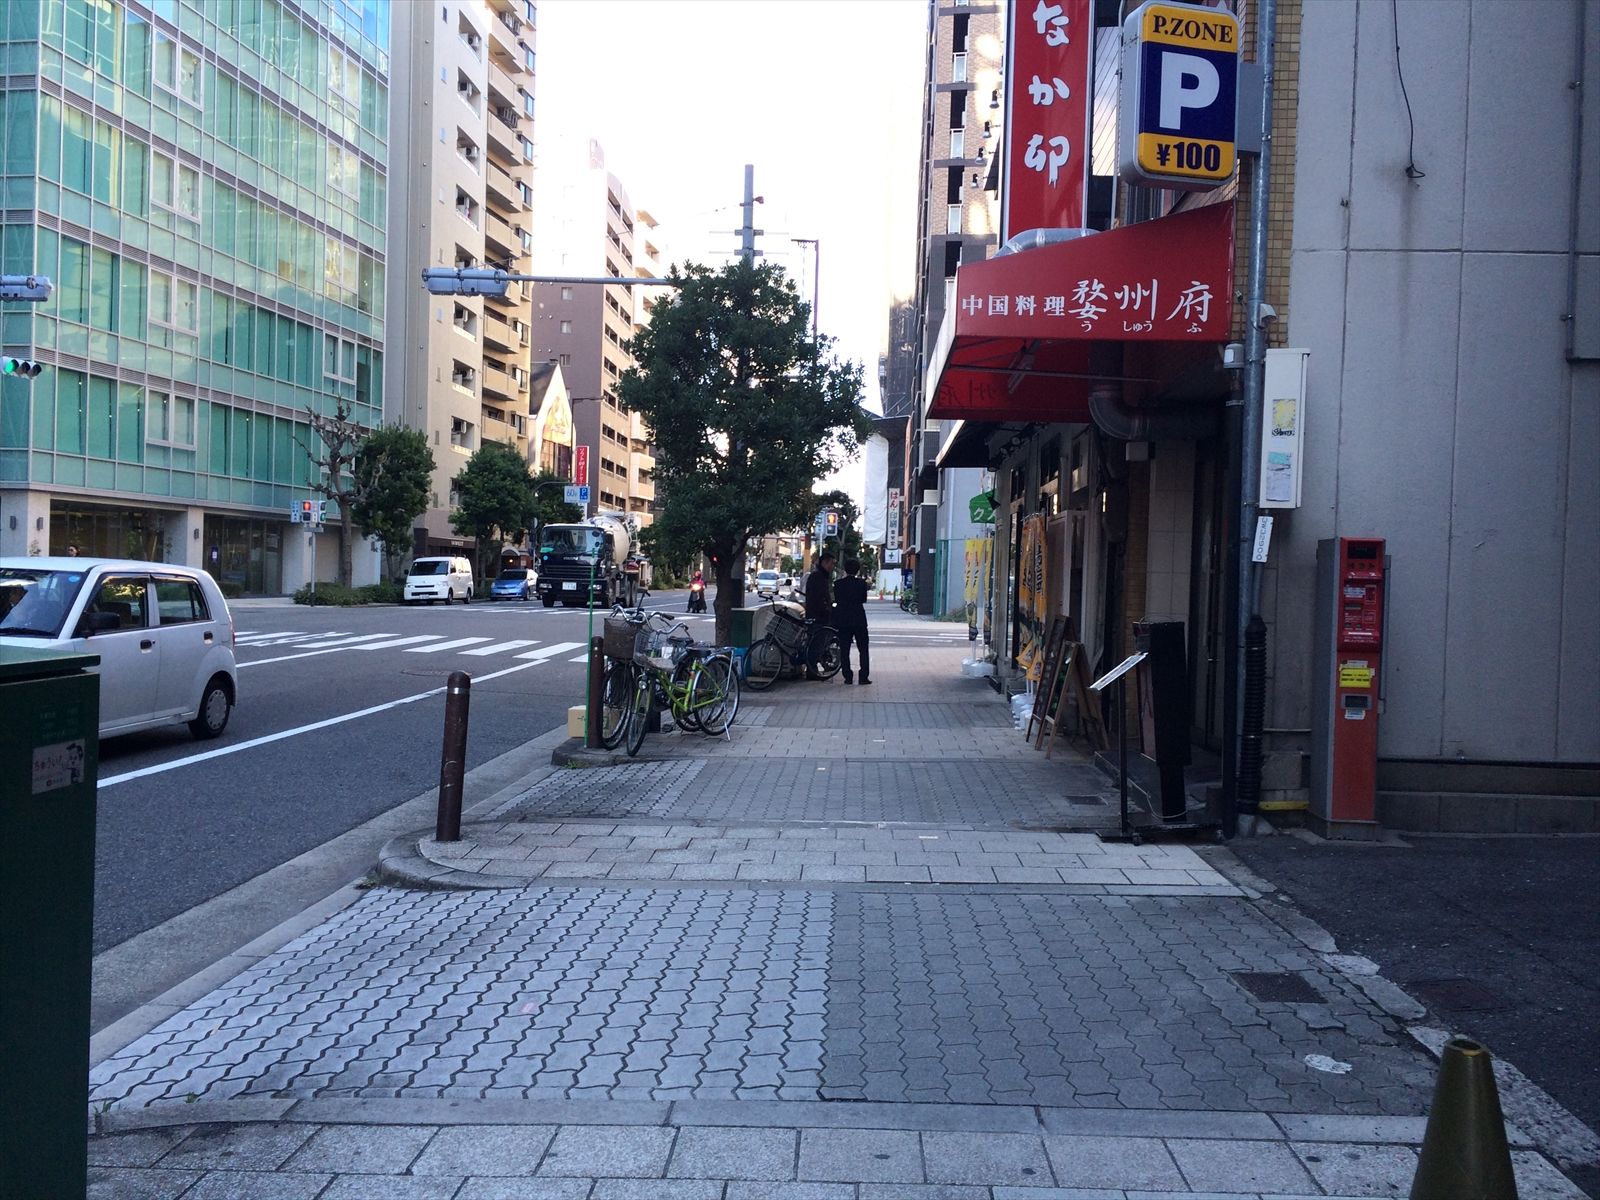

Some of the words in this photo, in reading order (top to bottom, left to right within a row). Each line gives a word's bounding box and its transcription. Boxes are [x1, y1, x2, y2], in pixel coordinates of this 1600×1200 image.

[1153, 15, 1233, 43] P.ZONE
[1024, 0, 1070, 189] なか卯
[1159, 51, 1220, 130] P
[1157, 142, 1221, 172] ¥100
[962, 295, 1065, 317] 中国料理
